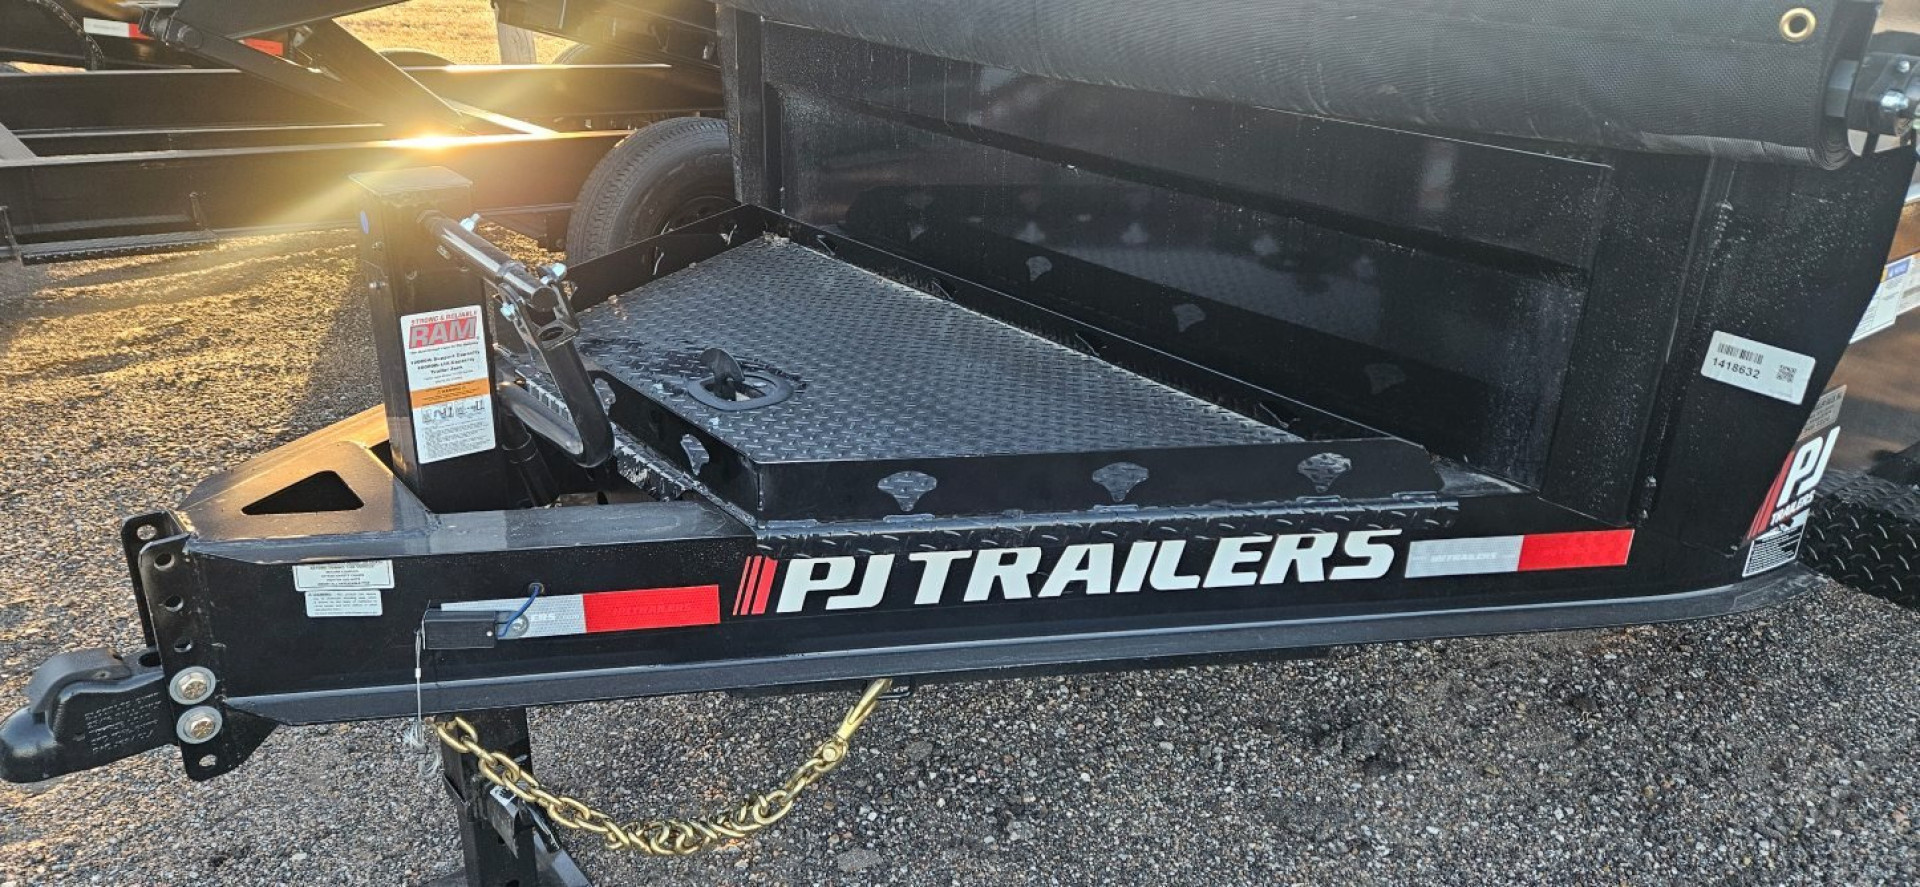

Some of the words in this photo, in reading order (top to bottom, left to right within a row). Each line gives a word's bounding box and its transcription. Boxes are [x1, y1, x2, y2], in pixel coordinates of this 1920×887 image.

[411, 315, 439, 326] STRONG
[411, 318, 476, 348] RAM
[1713, 357, 1760, 380] 1418632
[1776, 426, 1840, 508] PJ
[1770, 489, 1817, 527] TRAILERS
[776, 553, 895, 613] PJ
[908, 529, 1403, 605] TRAILERS
